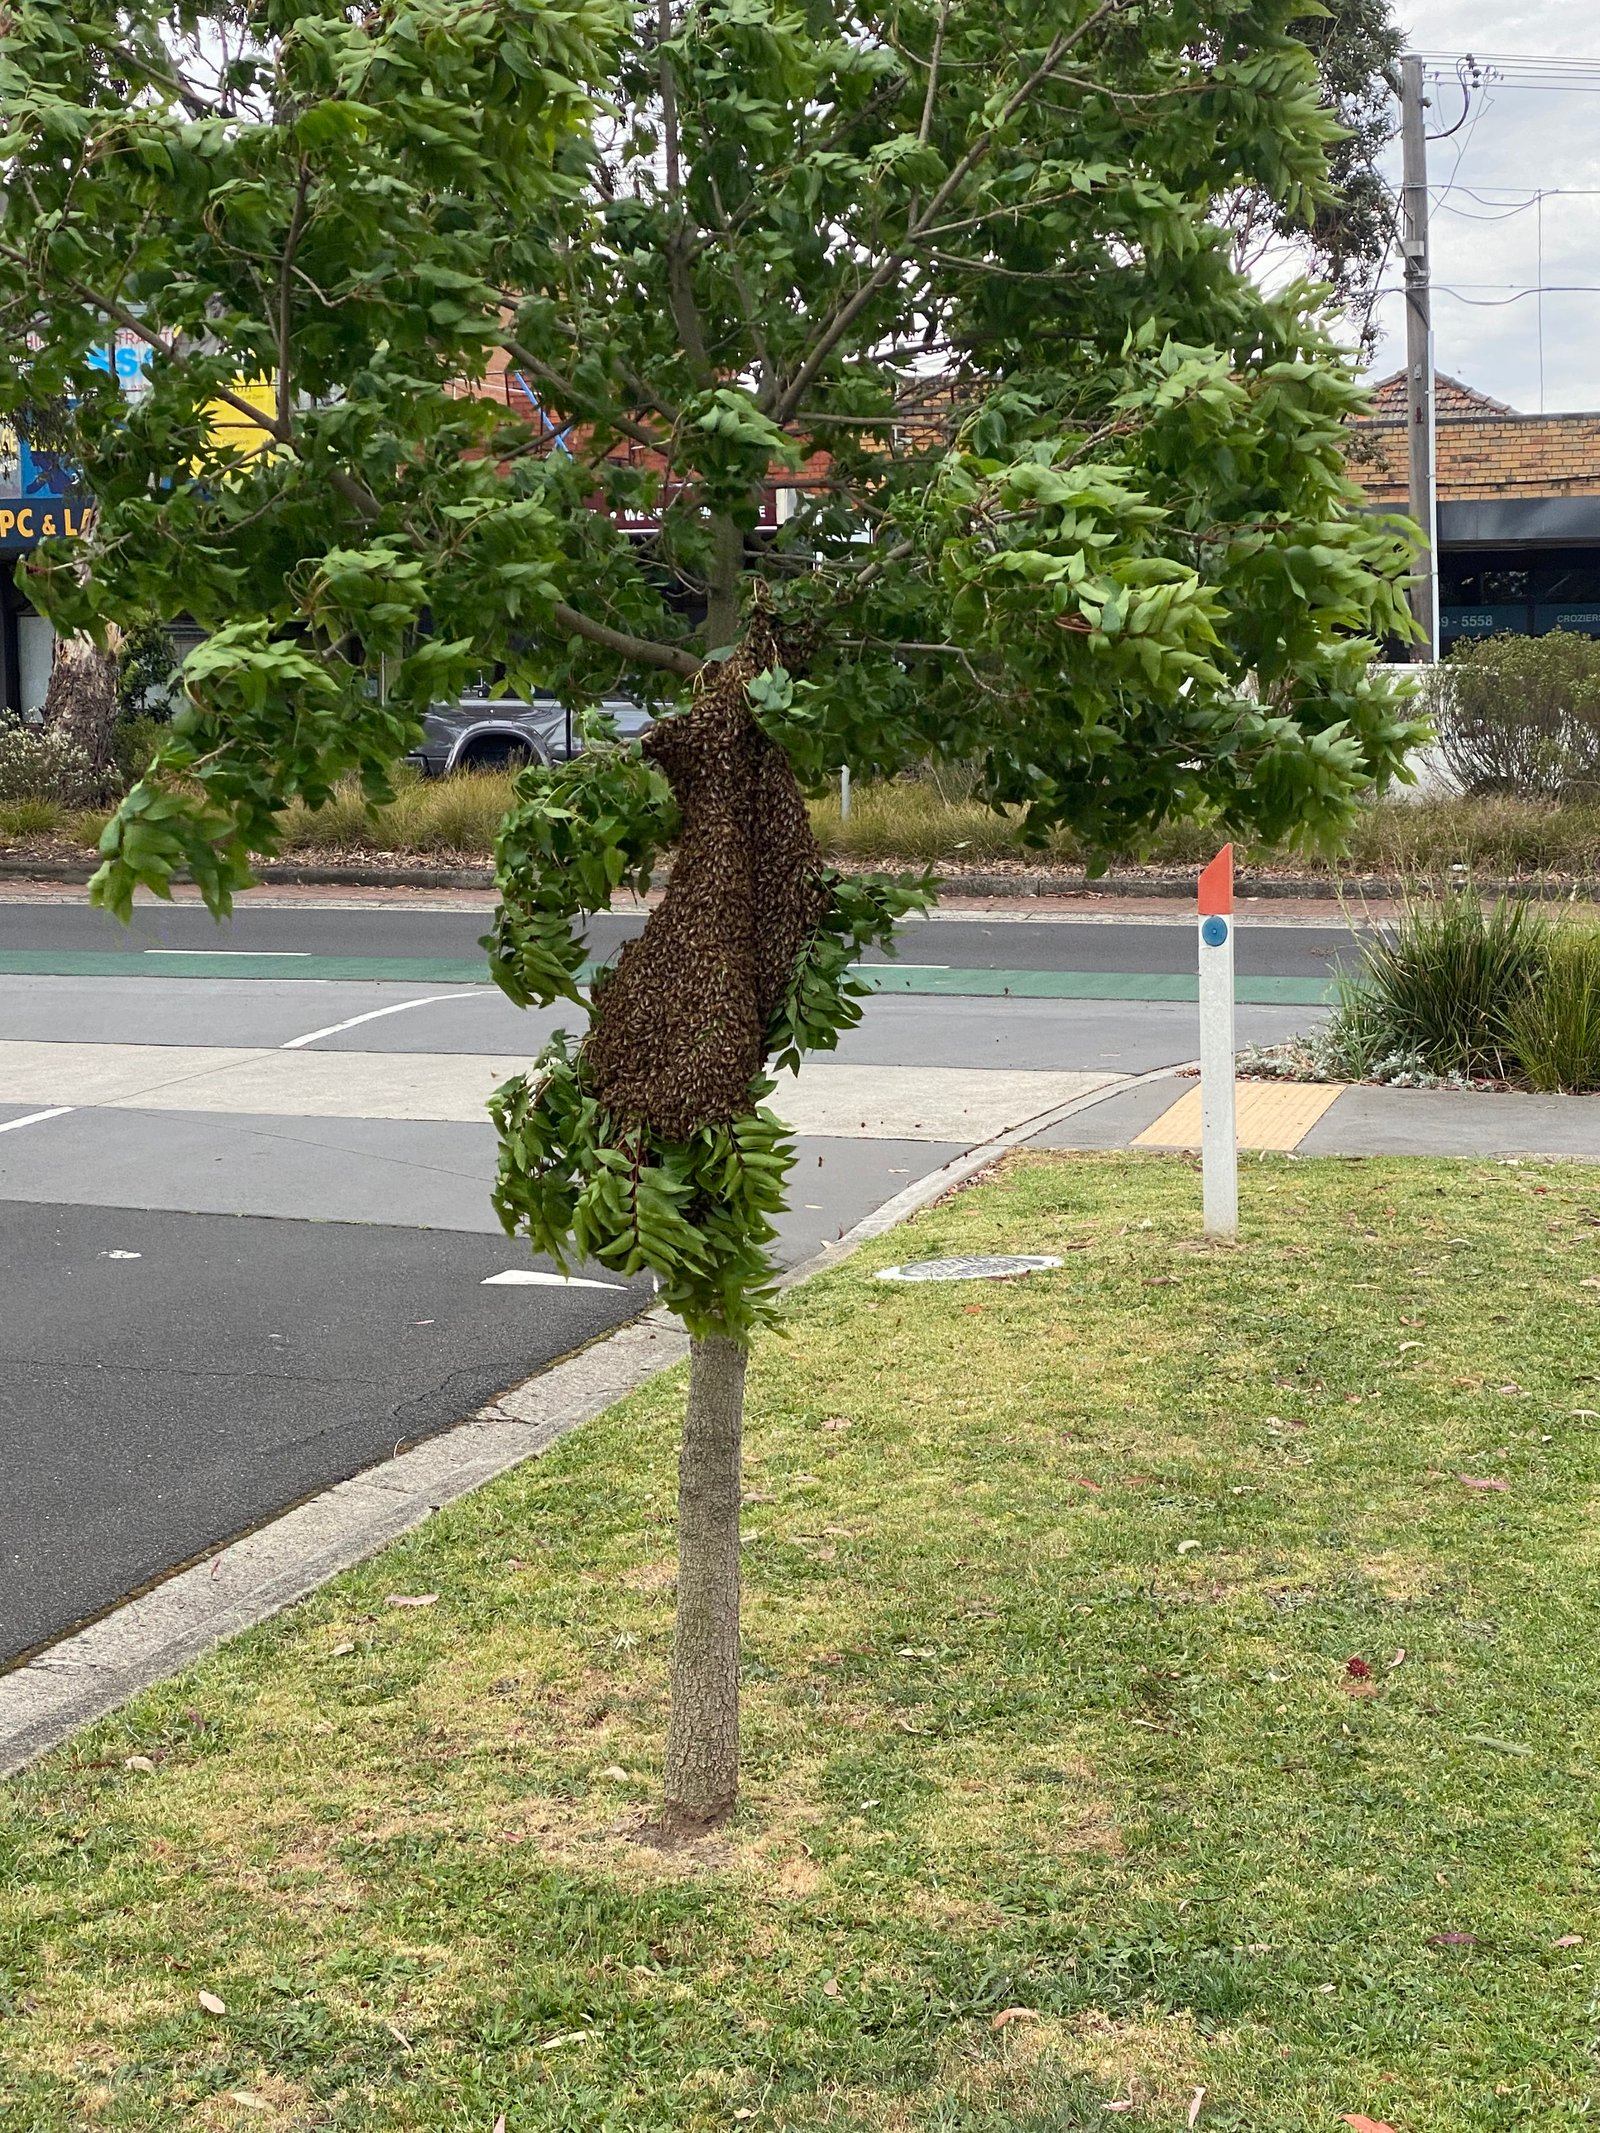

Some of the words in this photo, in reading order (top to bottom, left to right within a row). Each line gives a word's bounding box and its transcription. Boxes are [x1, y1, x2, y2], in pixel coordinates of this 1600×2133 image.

[0, 509, 34, 538] PC
[42, 514, 56, 535] &
[1461, 615, 1493, 627] 5558
[1556, 613, 1600, 623] CROZIER
